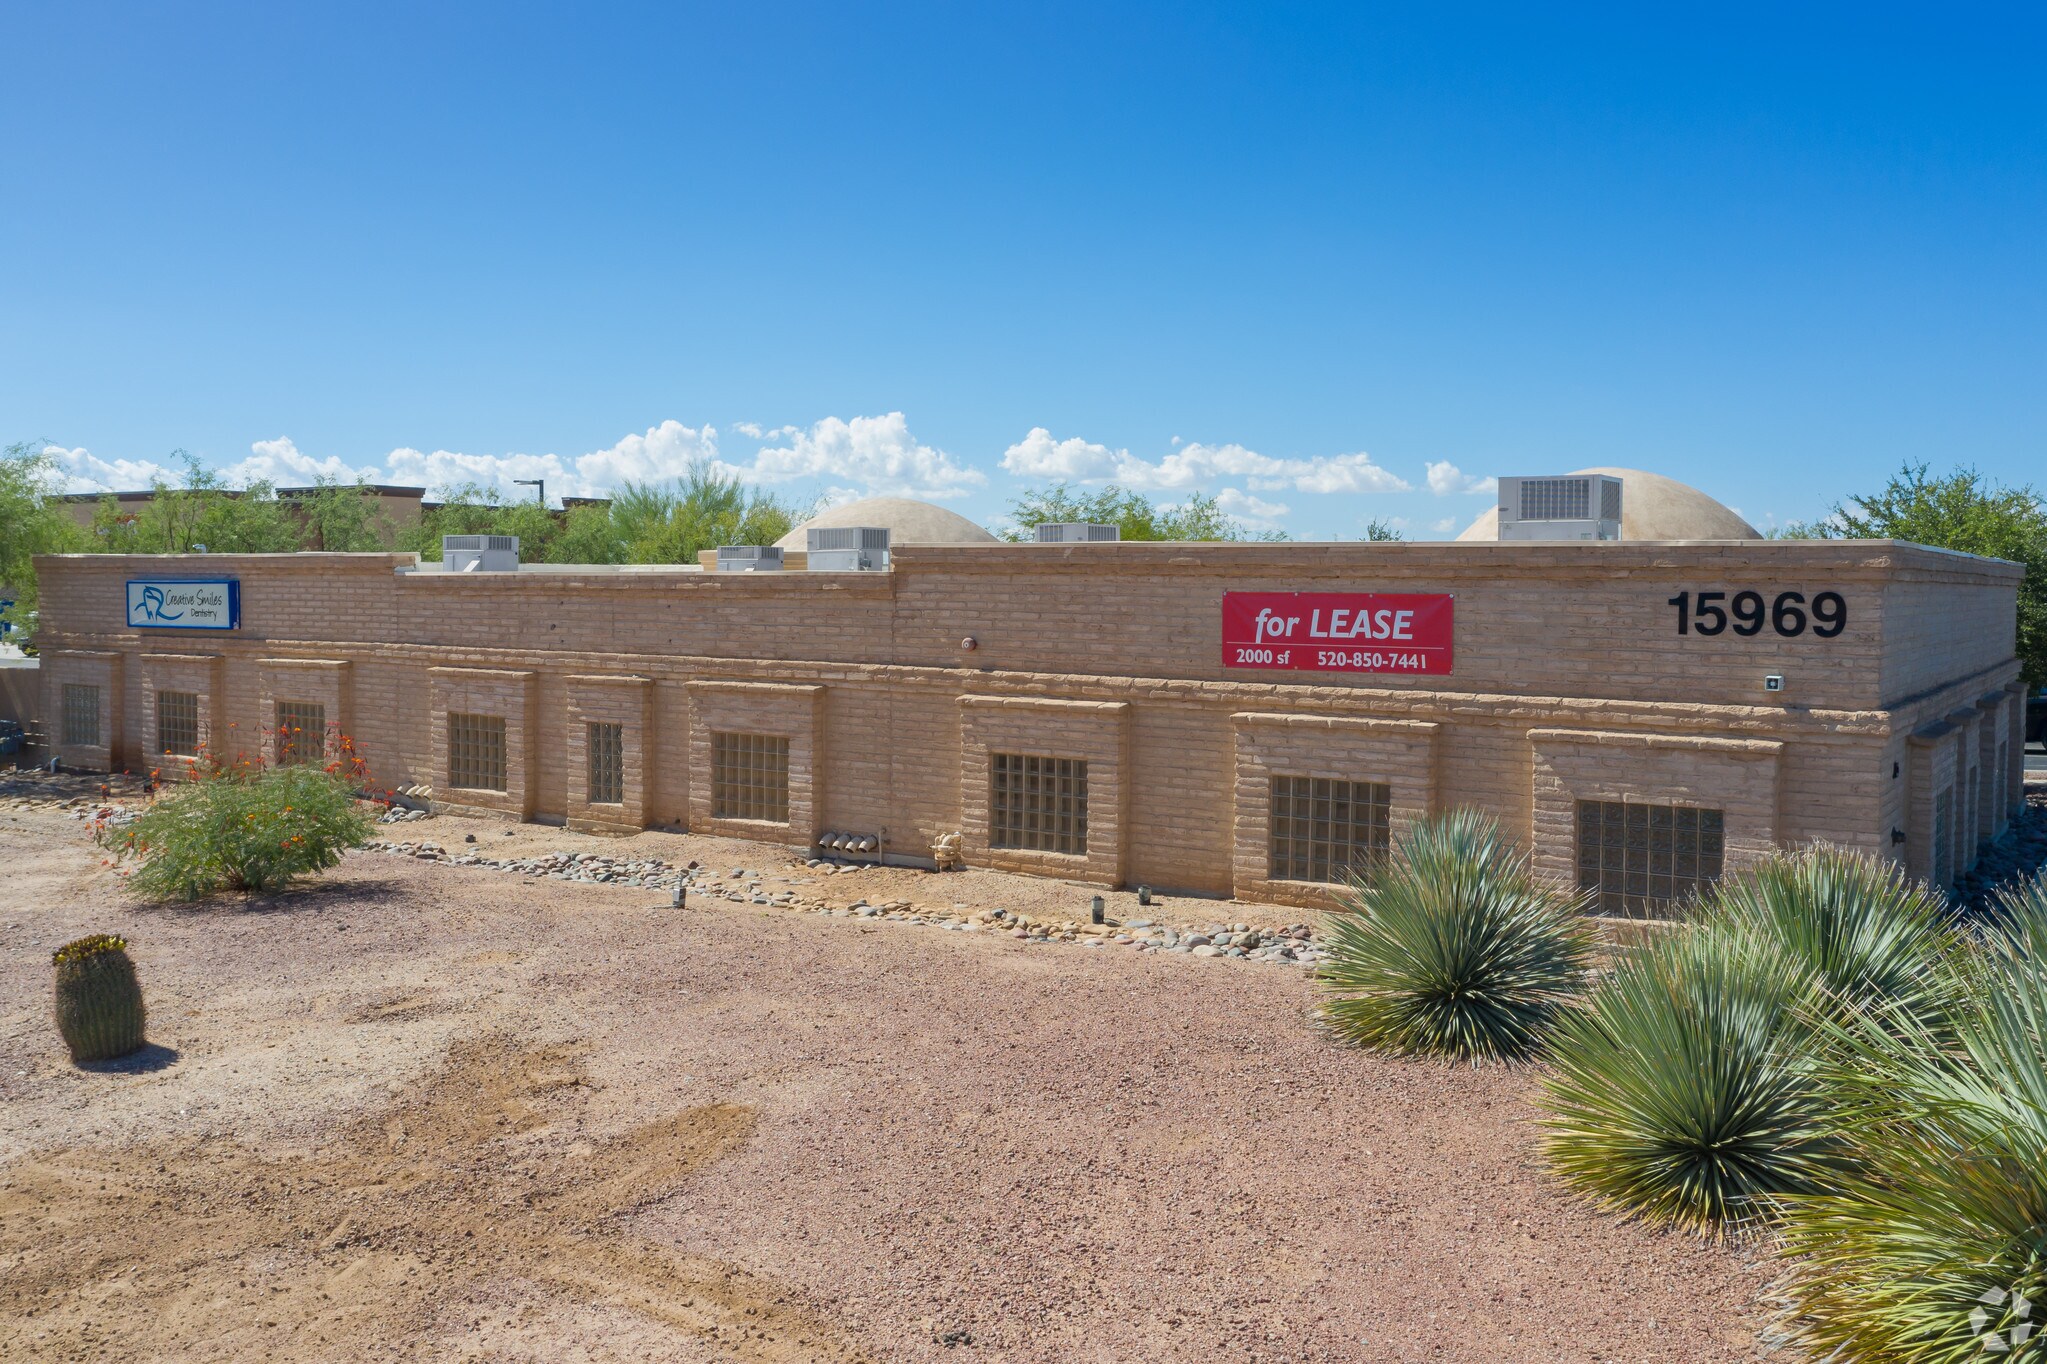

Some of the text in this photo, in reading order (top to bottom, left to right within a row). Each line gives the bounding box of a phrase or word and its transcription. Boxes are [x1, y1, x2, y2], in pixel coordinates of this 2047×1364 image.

[165, 588, 222, 606] Creative Smiles
[190, 608, 218, 621] Dentistry
[1668, 591, 1847, 638] 15969
[1255, 608, 1414, 644] for LEASE
[1236, 648, 1427, 669] 2000 sf 520-850-7441
